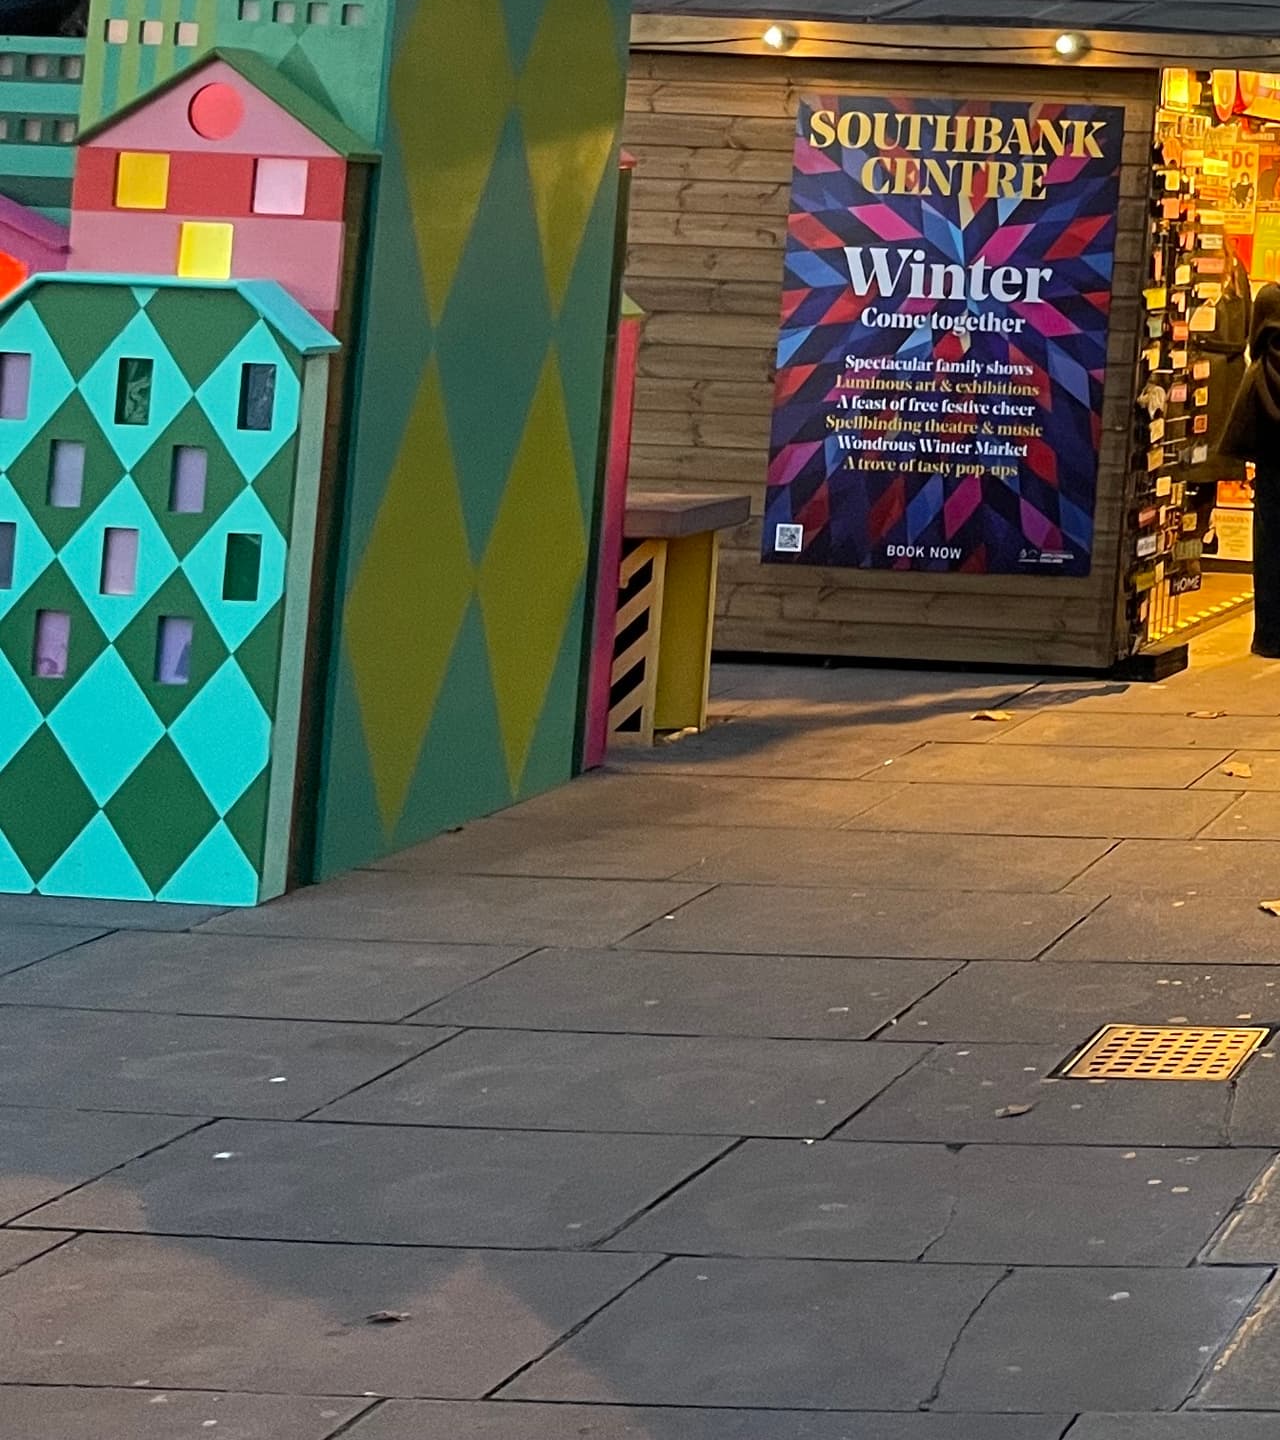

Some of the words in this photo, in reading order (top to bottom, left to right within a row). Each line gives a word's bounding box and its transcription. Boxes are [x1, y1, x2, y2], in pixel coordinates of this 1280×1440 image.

[809, 110, 1106, 159] SOUTHBANK
[860, 156, 1048, 201] CENTRE
[844, 246, 1053, 304] Winter
[860, 306, 926, 330] Come
[930, 309, 1026, 337] together
[845, 354, 932, 372] Spectacular
[935, 358, 984, 377] family
[986, 360, 1034, 376] shows
[835, 374, 912, 392] Luminous
[915, 378, 936, 392] art
[939, 379, 952, 393] &
[955, 380, 1041, 397] exhibitions
[836, 394, 848, 408] A
[851, 395, 888, 410] feast
[892, 396, 907, 410] of
[908, 398, 939, 412] free
[941, 398, 990, 414] festive
[991, 401, 1037, 417] cheer
[825, 415, 922, 434] Spellbinding
[924, 418, 978, 435] theatre
[981, 420, 995, 435] &
[997, 422, 1044, 437] music
[837, 435, 916, 452] Wondrous
[919, 438, 972, 455] Winter
[974, 440, 1028, 457] Market
[843, 456, 855, 470] A
[857, 458, 896, 471] trove
[899, 458, 916, 472] of
[917, 459, 953, 477] tasty
[955, 462, 1018, 479] pop-ups
[886, 544, 925, 558] BOOK
[930, 546, 962, 559] NOW
[1173, 574, 1200, 592] HOME
